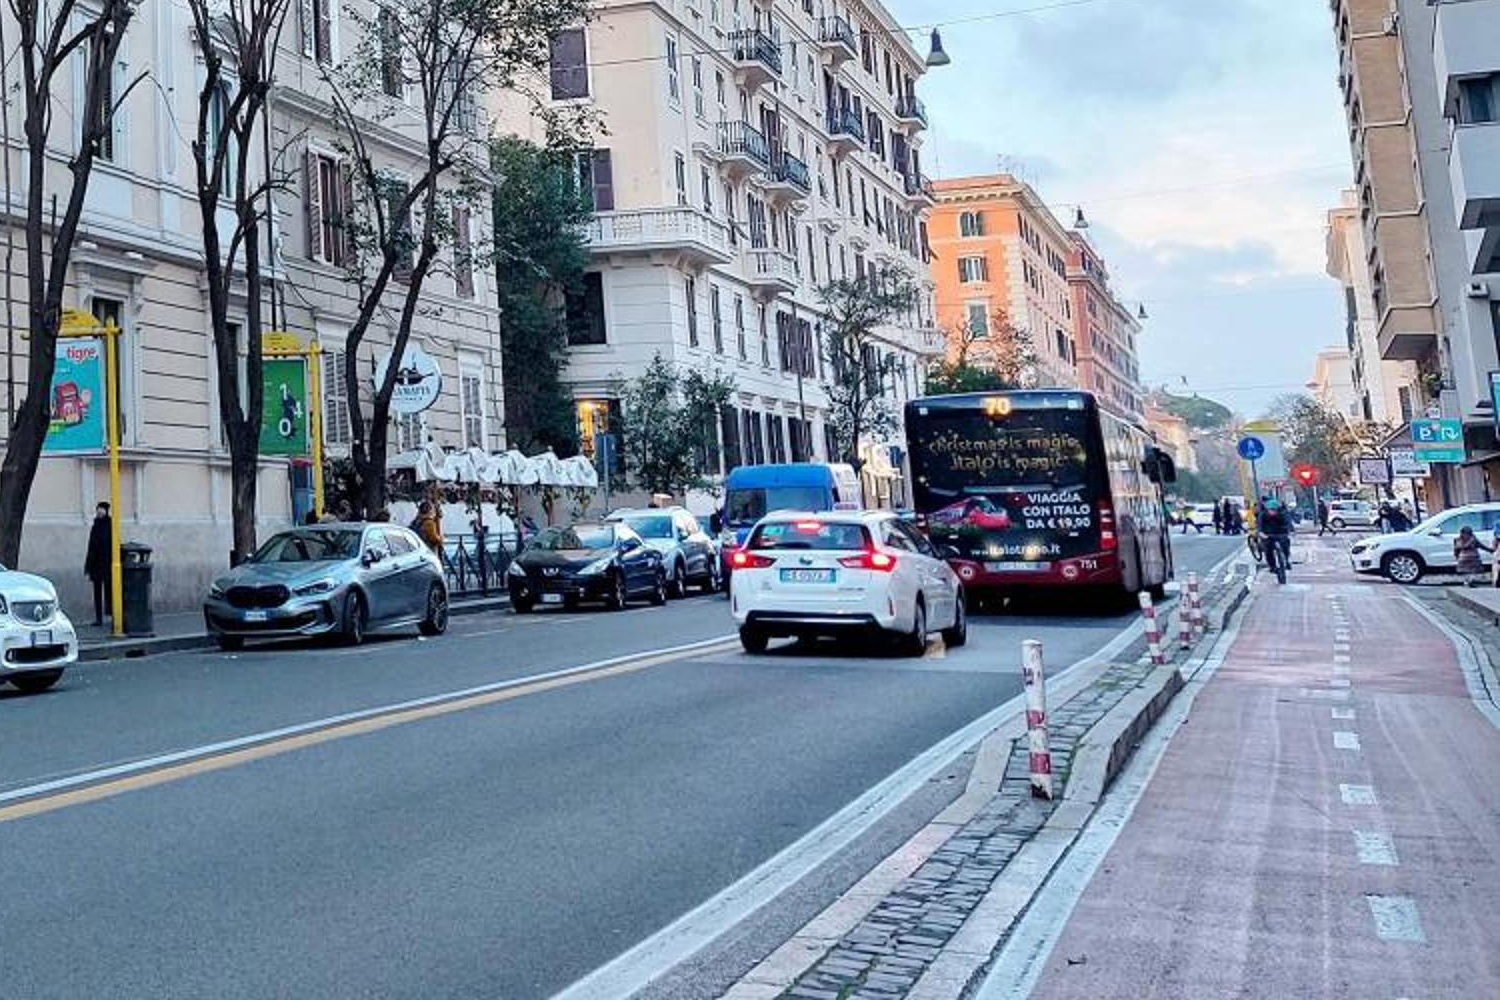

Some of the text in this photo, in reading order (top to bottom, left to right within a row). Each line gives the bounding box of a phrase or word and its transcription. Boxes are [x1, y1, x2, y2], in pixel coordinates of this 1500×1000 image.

[984, 397, 1010, 415] 70
[1027, 492, 1082, 504] VIAGGIA
[1022, 504, 1090, 517] CON ITALO
[1026, 518, 1045, 529] DA
